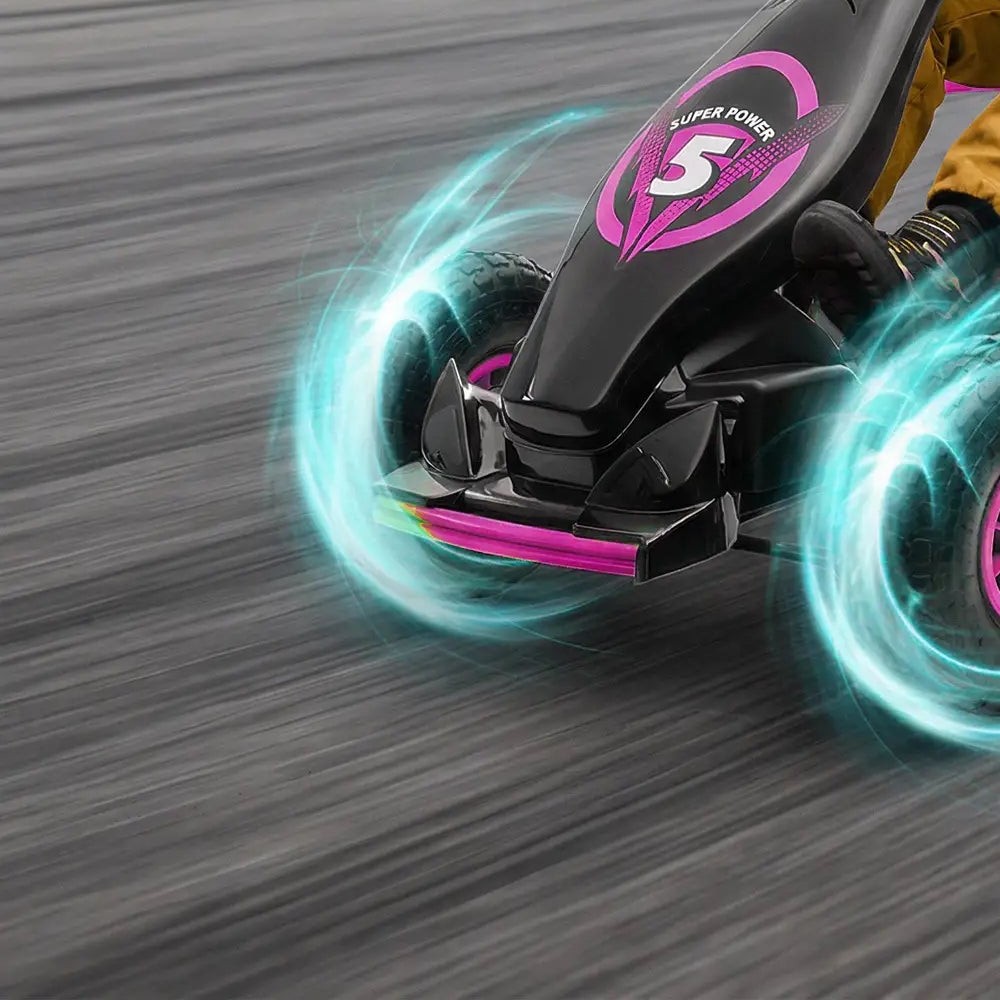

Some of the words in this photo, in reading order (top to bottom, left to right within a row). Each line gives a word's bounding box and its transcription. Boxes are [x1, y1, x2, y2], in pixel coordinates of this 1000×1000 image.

[669, 106, 724, 131] SUPER
[724, 106, 776, 142] POWER
[648, 135, 735, 197] 5
